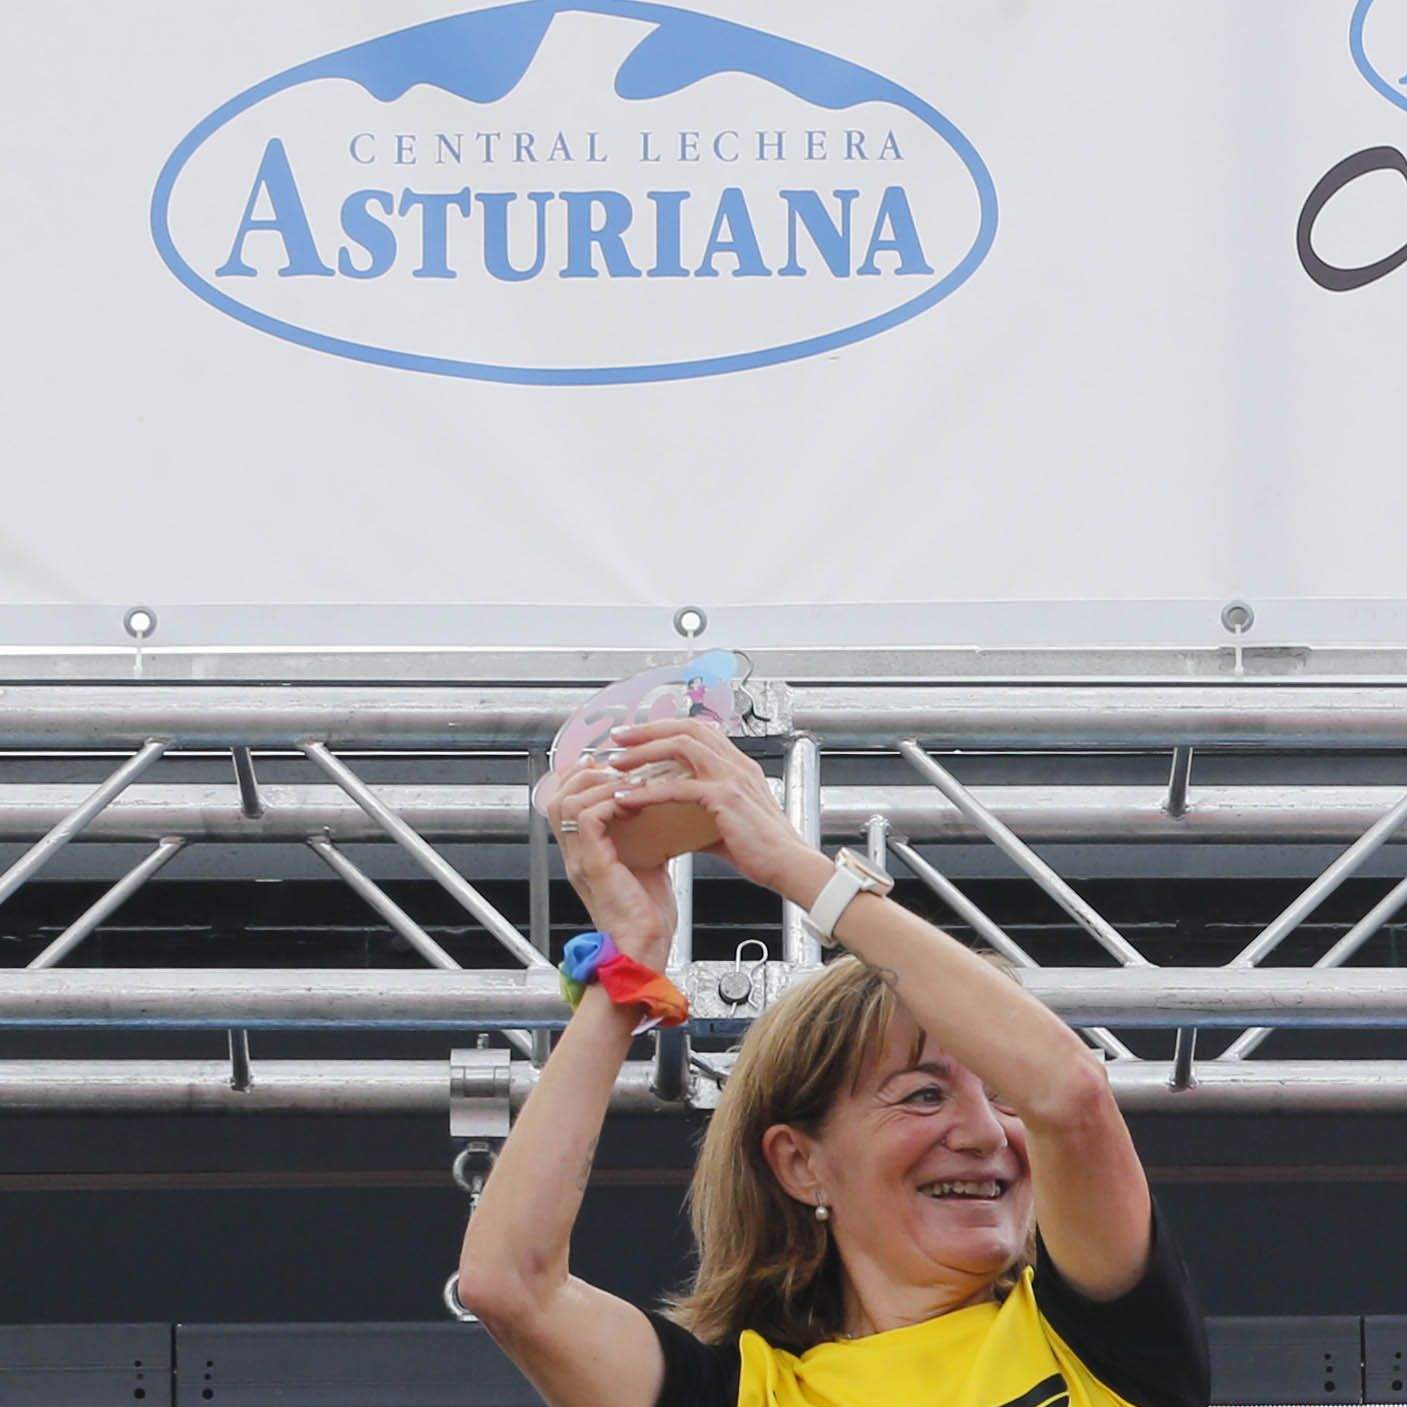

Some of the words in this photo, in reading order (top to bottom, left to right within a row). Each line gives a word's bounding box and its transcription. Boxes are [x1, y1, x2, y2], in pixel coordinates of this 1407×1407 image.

[349, 131, 610, 166] CENTRAL
[639, 129, 906, 164] LECHERA
[215, 137, 935, 282] ASTURIANA
